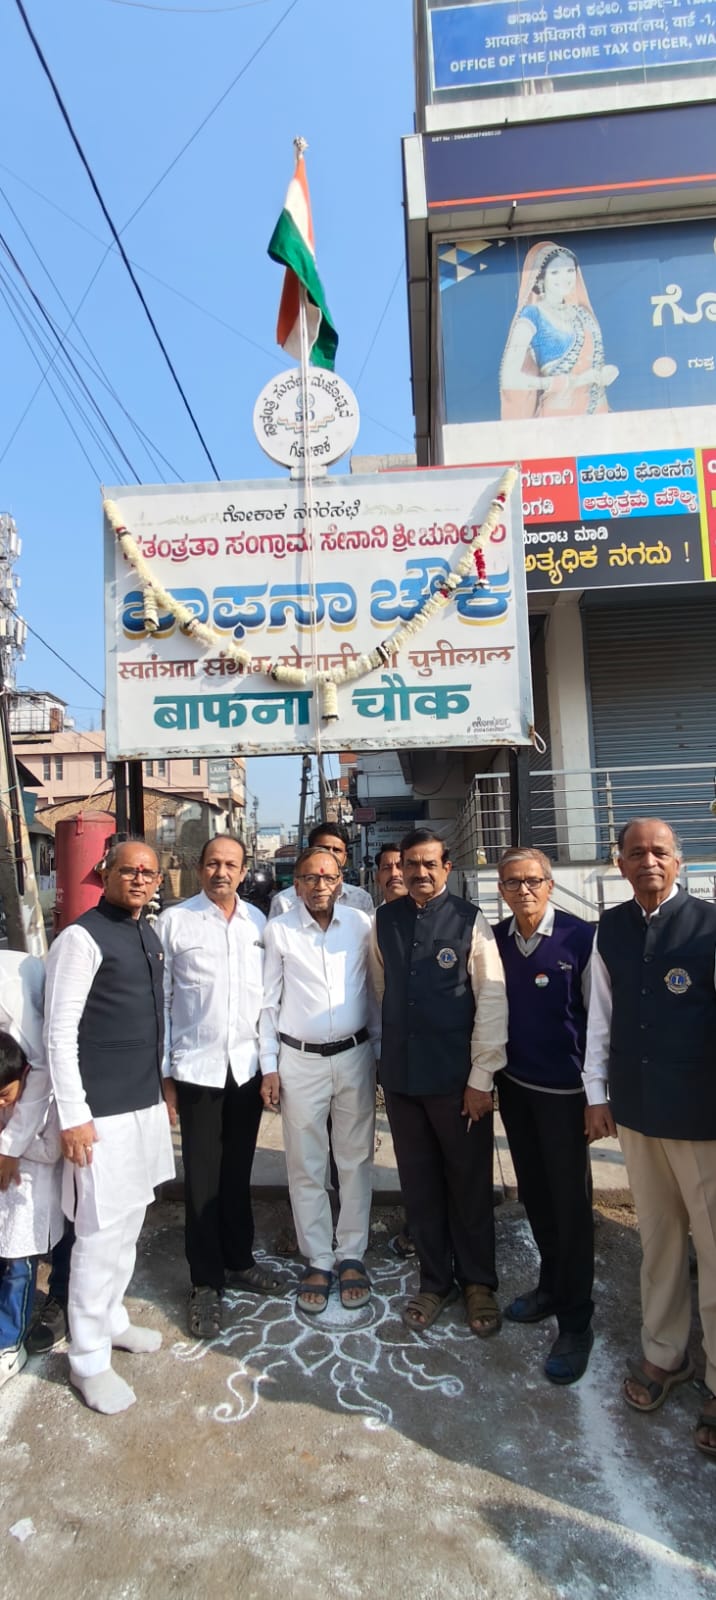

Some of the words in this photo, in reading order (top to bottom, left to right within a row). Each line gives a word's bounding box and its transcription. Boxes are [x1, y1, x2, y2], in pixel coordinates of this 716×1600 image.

[450, 55, 496, 73] OFFICE
[499, 54, 515, 67] OF
[519, 51, 545, 65] THE
[549, 46, 600, 62] INCOME
[603, 41, 629, 56] TAX
[632, 35, 693, 53] OFFICER,
[485, 33, 529, 49] आयकर
[532, 23, 587, 43] अधिकारी
[589, 24, 607, 38] का
[520, 467, 574, 487] ಗಳಿಗಾಗಿ
[580, 463, 628, 484] ಹಳೆಯ
[222, 503, 287, 523] ಗೋಕಾಕ
[293, 498, 361, 520] ನಗರಸಭೆ
[583, 490, 649, 518] ಅತ್ಯುತ್ತಮ
[654, 484, 699, 514] ಮೌಲ್ಯ
[123, 533, 220, 568] ತಂತ್ರತಾ
[225, 529, 313, 559] ಸಂಗ್ರಾಮ
[320, 524, 388, 551] ಸೇನಾನಿ
[392, 522, 416, 553] ಶ್ರೀ
[574, 525, 609, 543] ಮಾಡಿ
[524, 545, 598, 585] ಅತ್ಯಧಿಕ
[608, 538, 672, 567] ನಗದು
[117, 653, 199, 680] स्वतंत्रता
[408, 638, 516, 678] चुनीलाल
[153, 689, 314, 731] बाफना
[351, 672, 472, 722] चौक
